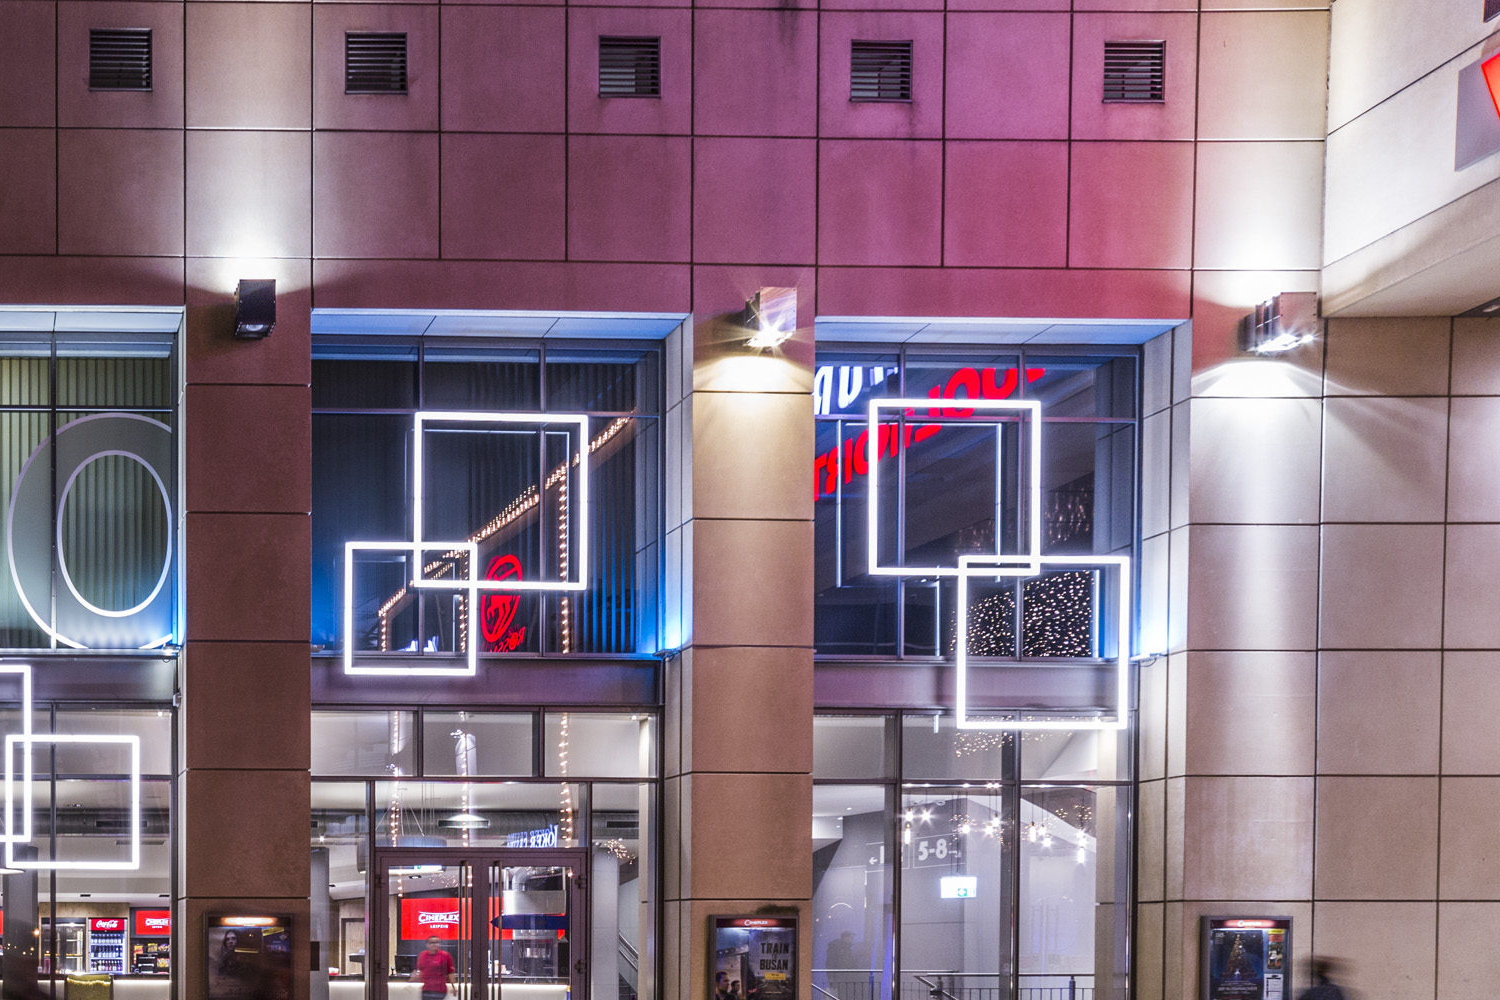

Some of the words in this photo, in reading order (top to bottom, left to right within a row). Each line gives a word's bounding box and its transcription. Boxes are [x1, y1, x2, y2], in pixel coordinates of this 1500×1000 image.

[918, 838, 948, 861] 5-8
[418, 913, 460, 924] CINEPLEX
[761, 942, 789, 955] TRAIN
[760, 959, 788, 970] BUSAN
